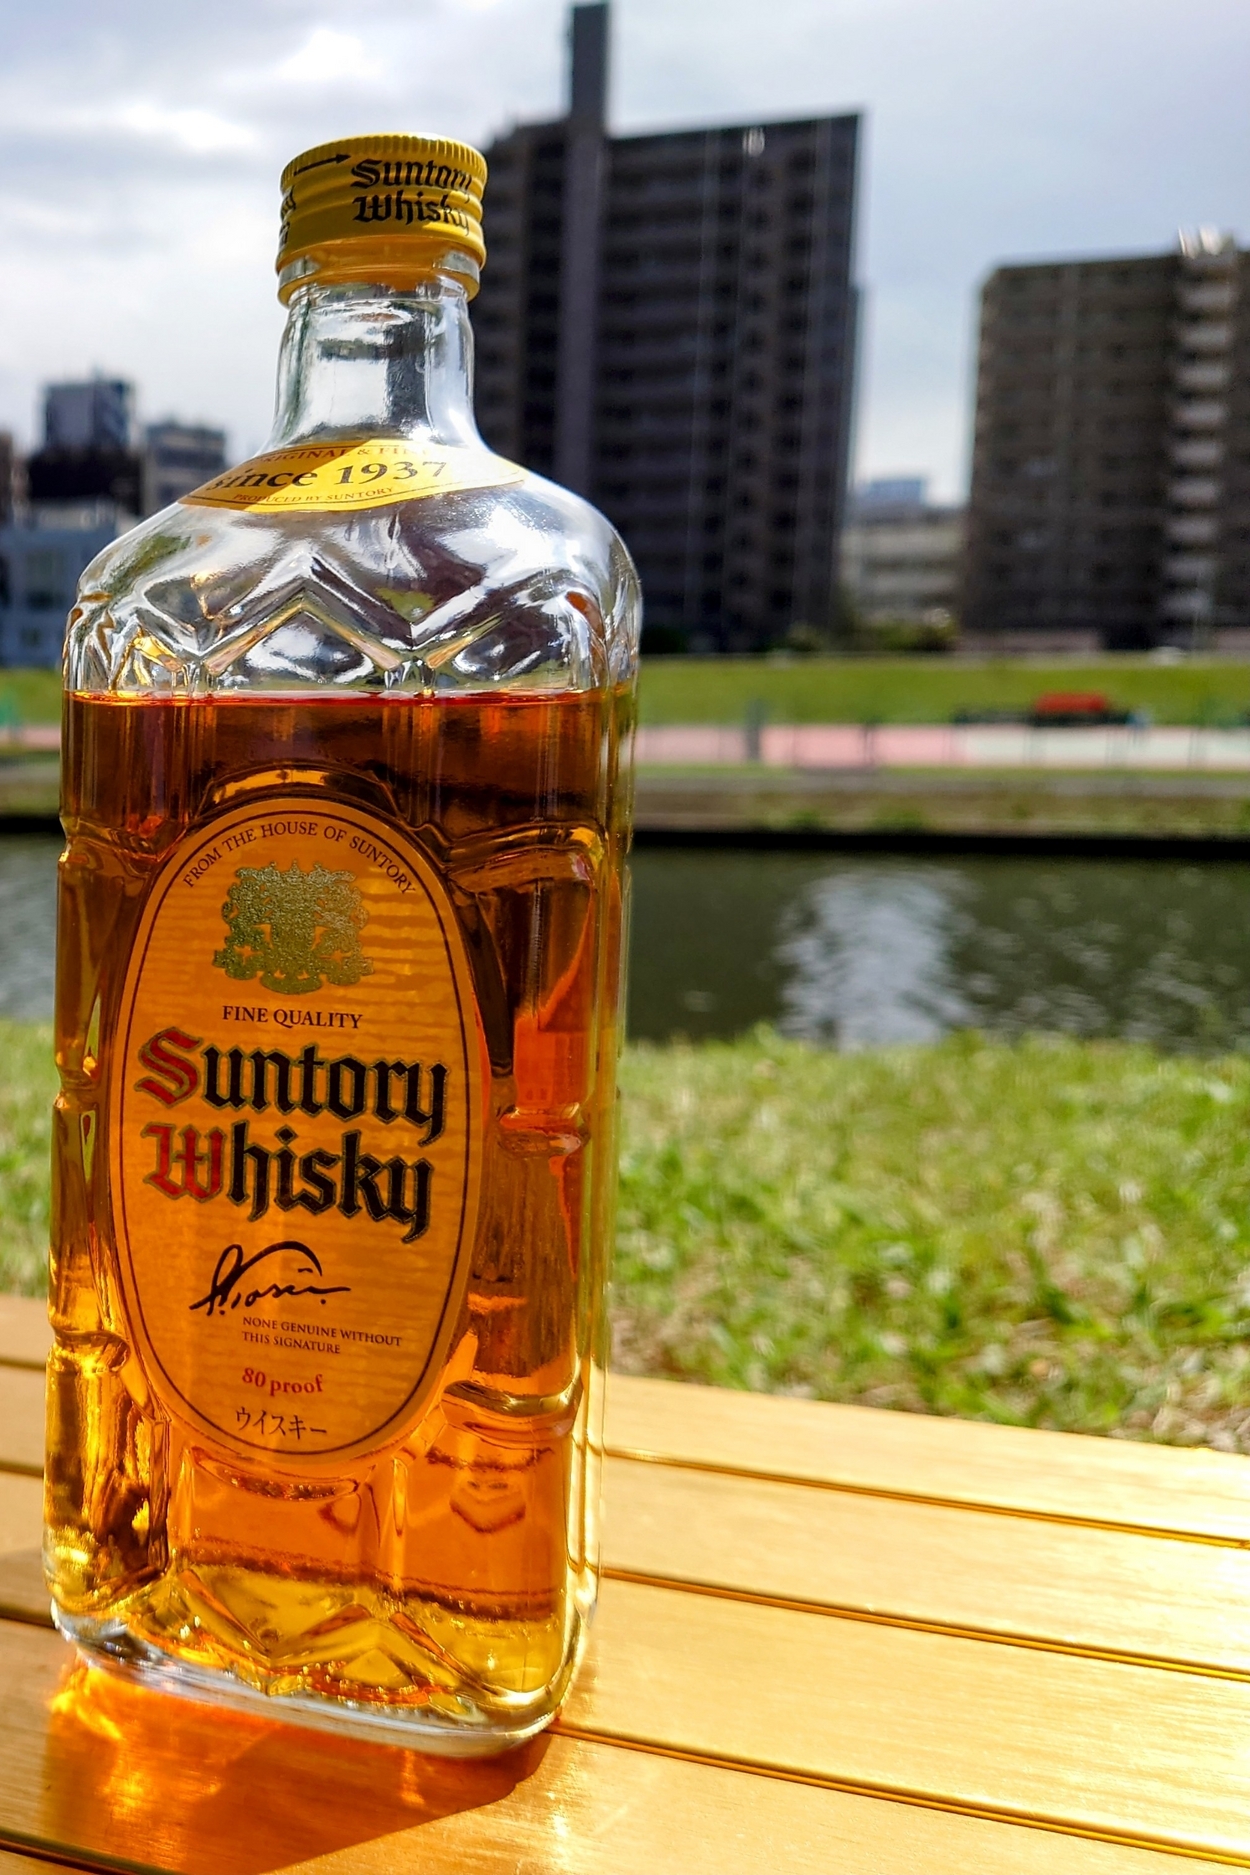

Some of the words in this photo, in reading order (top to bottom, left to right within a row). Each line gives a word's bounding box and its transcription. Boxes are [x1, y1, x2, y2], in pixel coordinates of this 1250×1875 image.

[351, 158, 473, 204] Suntory
[352, 189, 470, 236] Whisky
[206, 468, 318, 490] since
[335, 461, 447, 485] 1937
[327, 486, 395, 501] SUNTORY
[182, 847, 224, 889] FROM
[221, 827, 258, 853] THE
[260, 820, 319, 839] HOUSE
[324, 825, 348, 842] OF
[349, 834, 418, 896] SUNTORY
[222, 1005, 269, 1024] FINE
[272, 1008, 364, 1030] QUALITY
[133, 1026, 450, 1148] Suntory
[140, 1118, 435, 1244] Whisky
[241, 1330, 271, 1345] THIS
[272, 1335, 341, 1354] SIGNATURE
[242, 1316, 279, 1330] NONE
[280, 1321, 338, 1338] GENUINE
[339, 1330, 403, 1347] WITHOUT
[241, 1366, 267, 1388] 80
[269, 1373, 325, 1397] proof
[235, 1405, 328, 1440] ウイスキー
